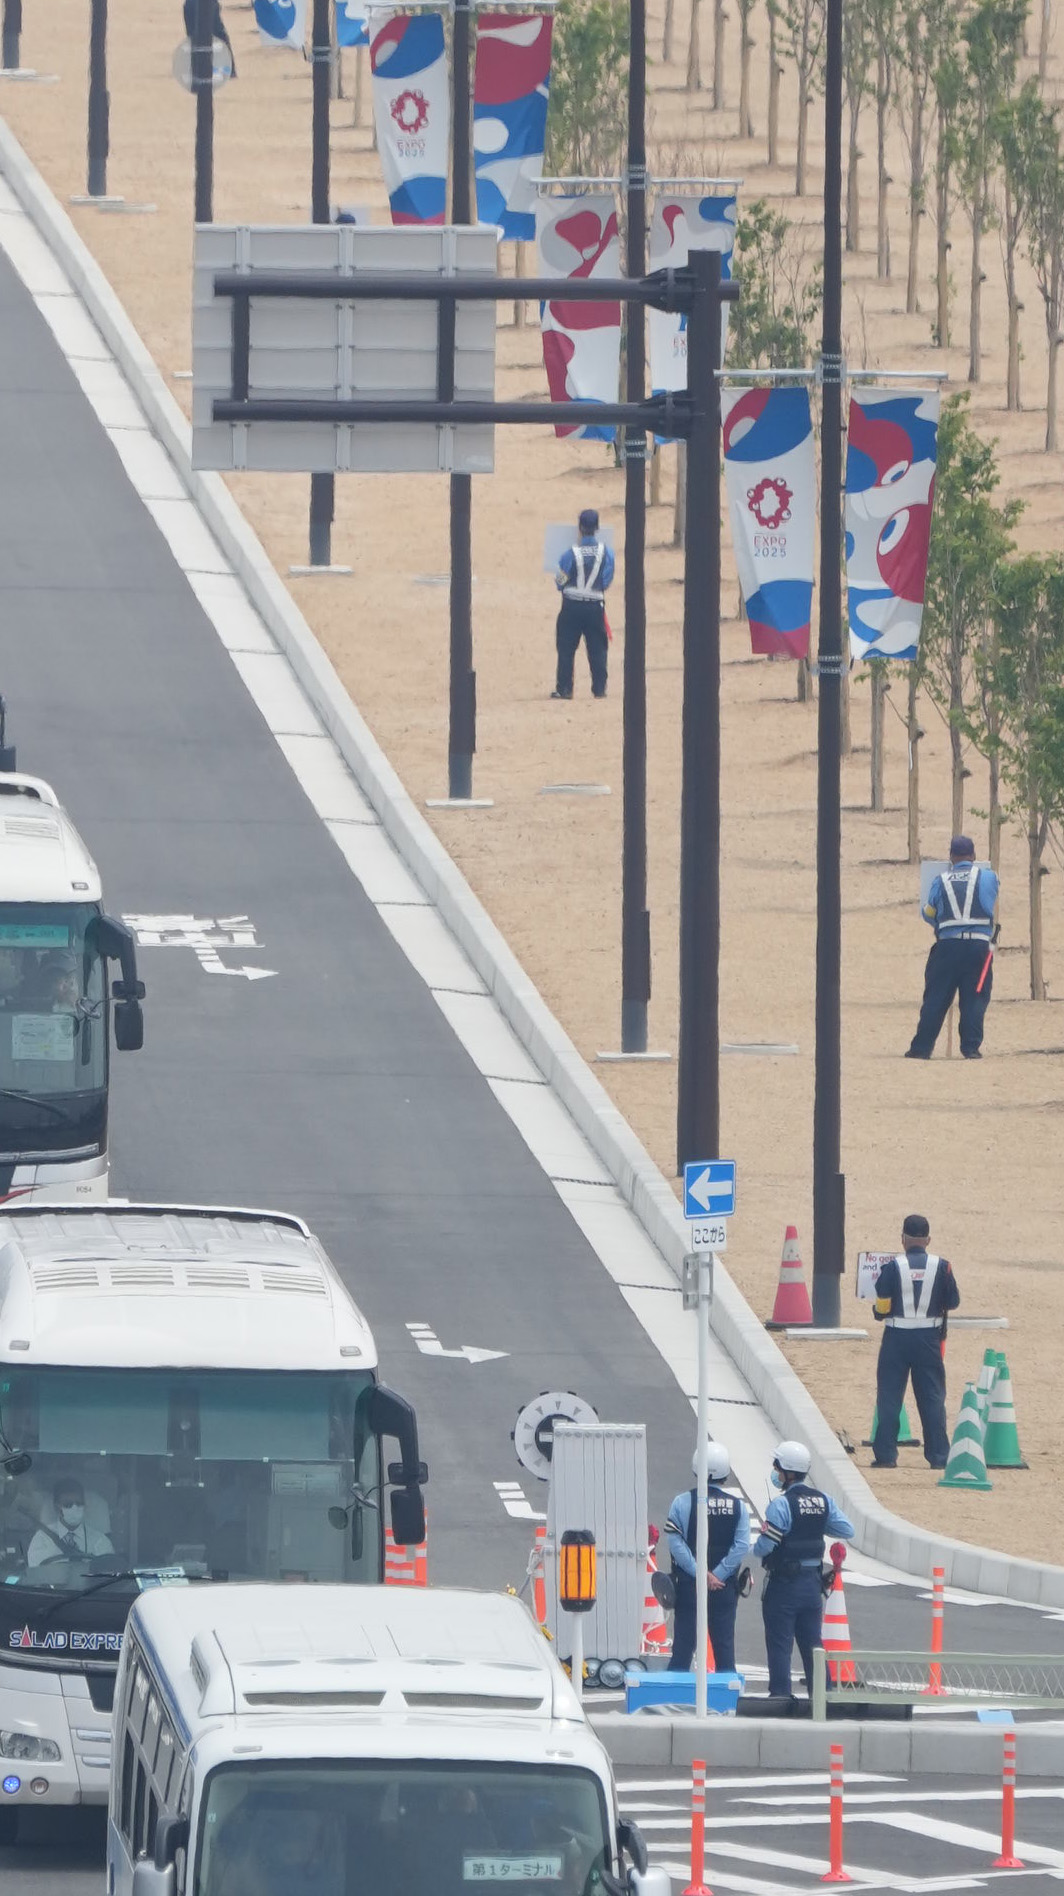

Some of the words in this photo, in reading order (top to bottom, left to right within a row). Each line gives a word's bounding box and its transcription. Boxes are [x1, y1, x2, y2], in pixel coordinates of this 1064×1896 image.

[753, 535, 787, 547] EXPO
[754, 546, 787, 558] 2025
[694, 1226, 726, 1244] ここから
[9, 1623, 68, 1649] SALAD
